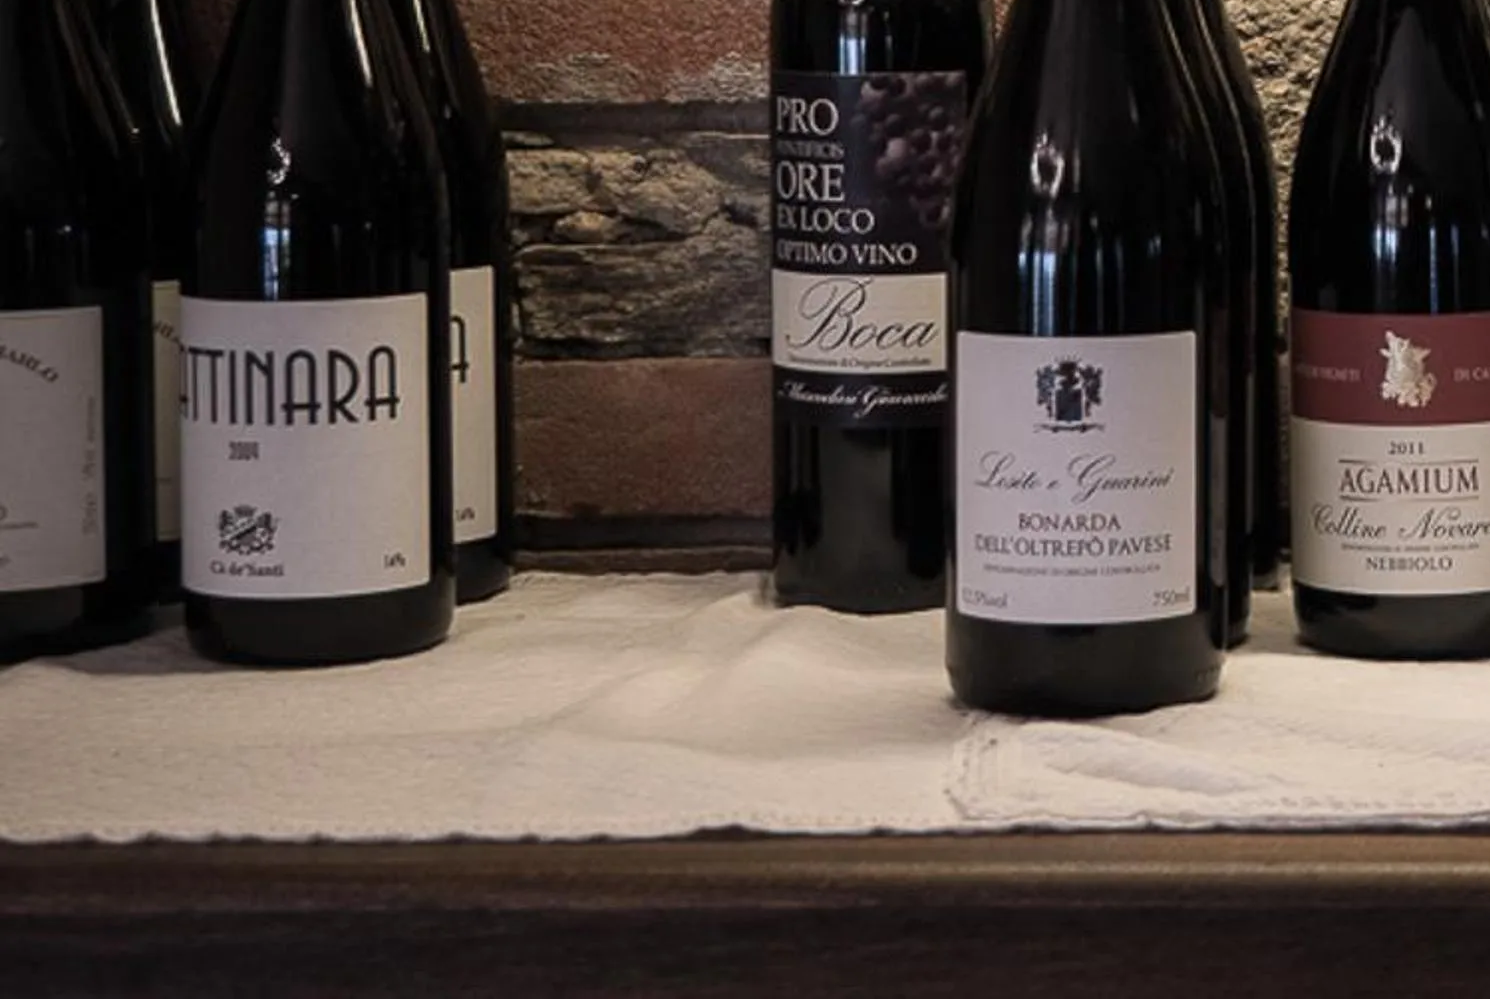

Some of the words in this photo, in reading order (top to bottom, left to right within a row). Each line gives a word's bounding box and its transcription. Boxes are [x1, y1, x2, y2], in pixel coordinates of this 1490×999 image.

[776, 96, 839, 135] PRO
[776, 160, 845, 202] ORE
[800, 207, 875, 234] LOCO
[852, 242, 918, 265] VINO
[785, 276, 940, 351] Boca
[1388, 441, 1425, 455] 2011
[1338, 465, 1480, 494] AGAMIUM
[1018, 513, 1122, 533] BONARDA
[1310, 503, 1388, 540] Colline
[1108, 533, 1173, 556] PAVESE
